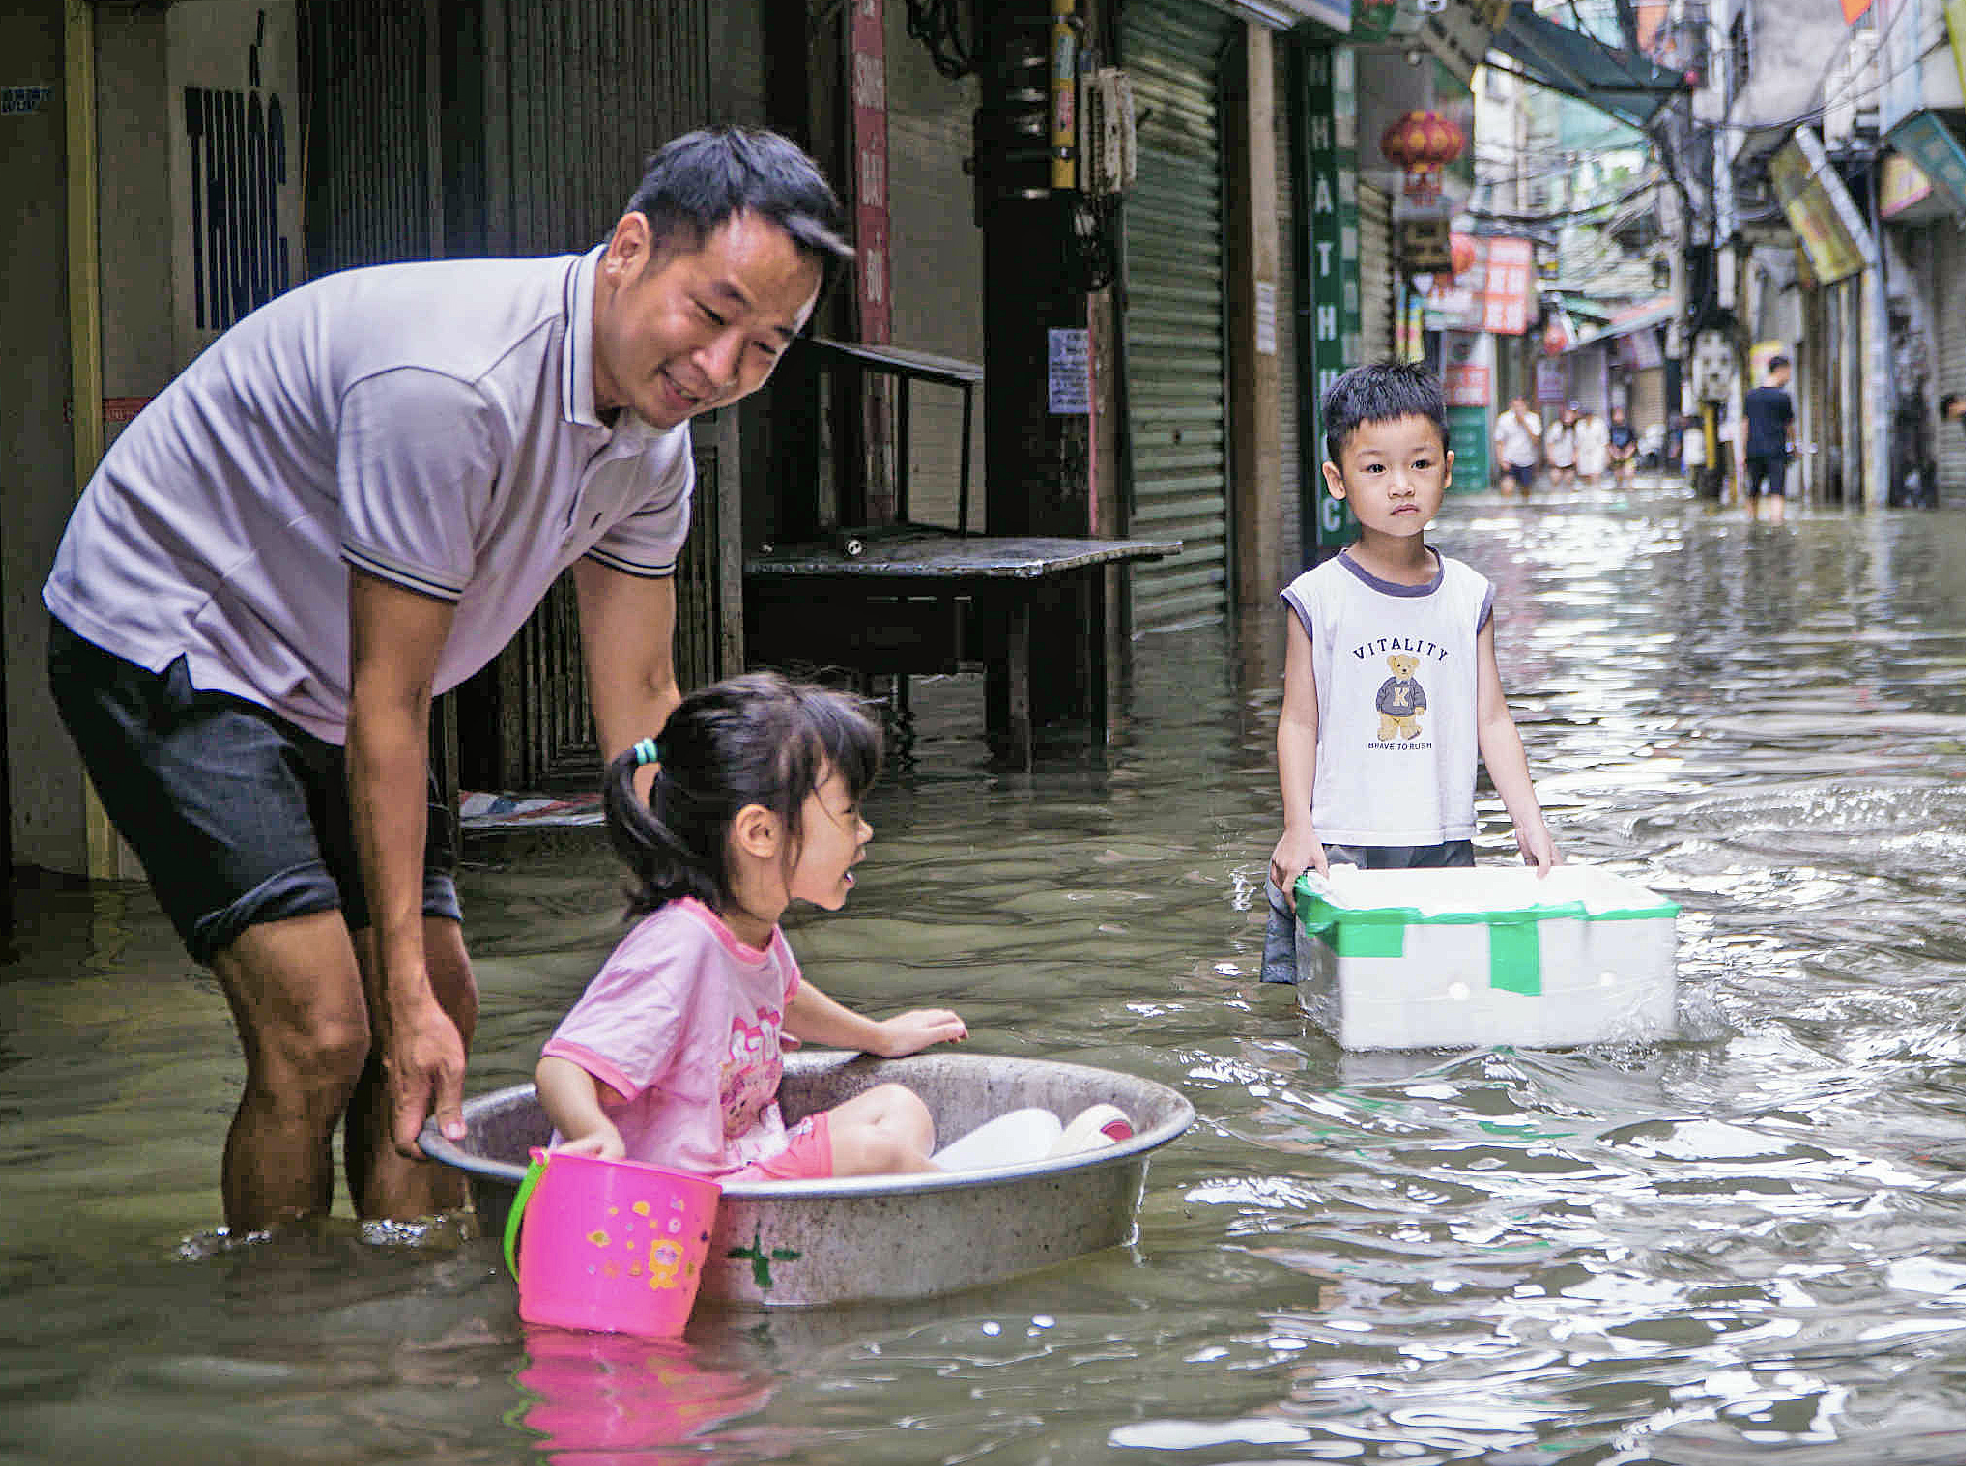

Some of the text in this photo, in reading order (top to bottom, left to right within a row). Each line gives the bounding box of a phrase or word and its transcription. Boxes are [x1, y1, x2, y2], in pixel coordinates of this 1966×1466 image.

[1353, 637, 1448, 661] VITALITY
[1392, 687, 1409, 707] K
[1396, 743, 1408, 751] TO
